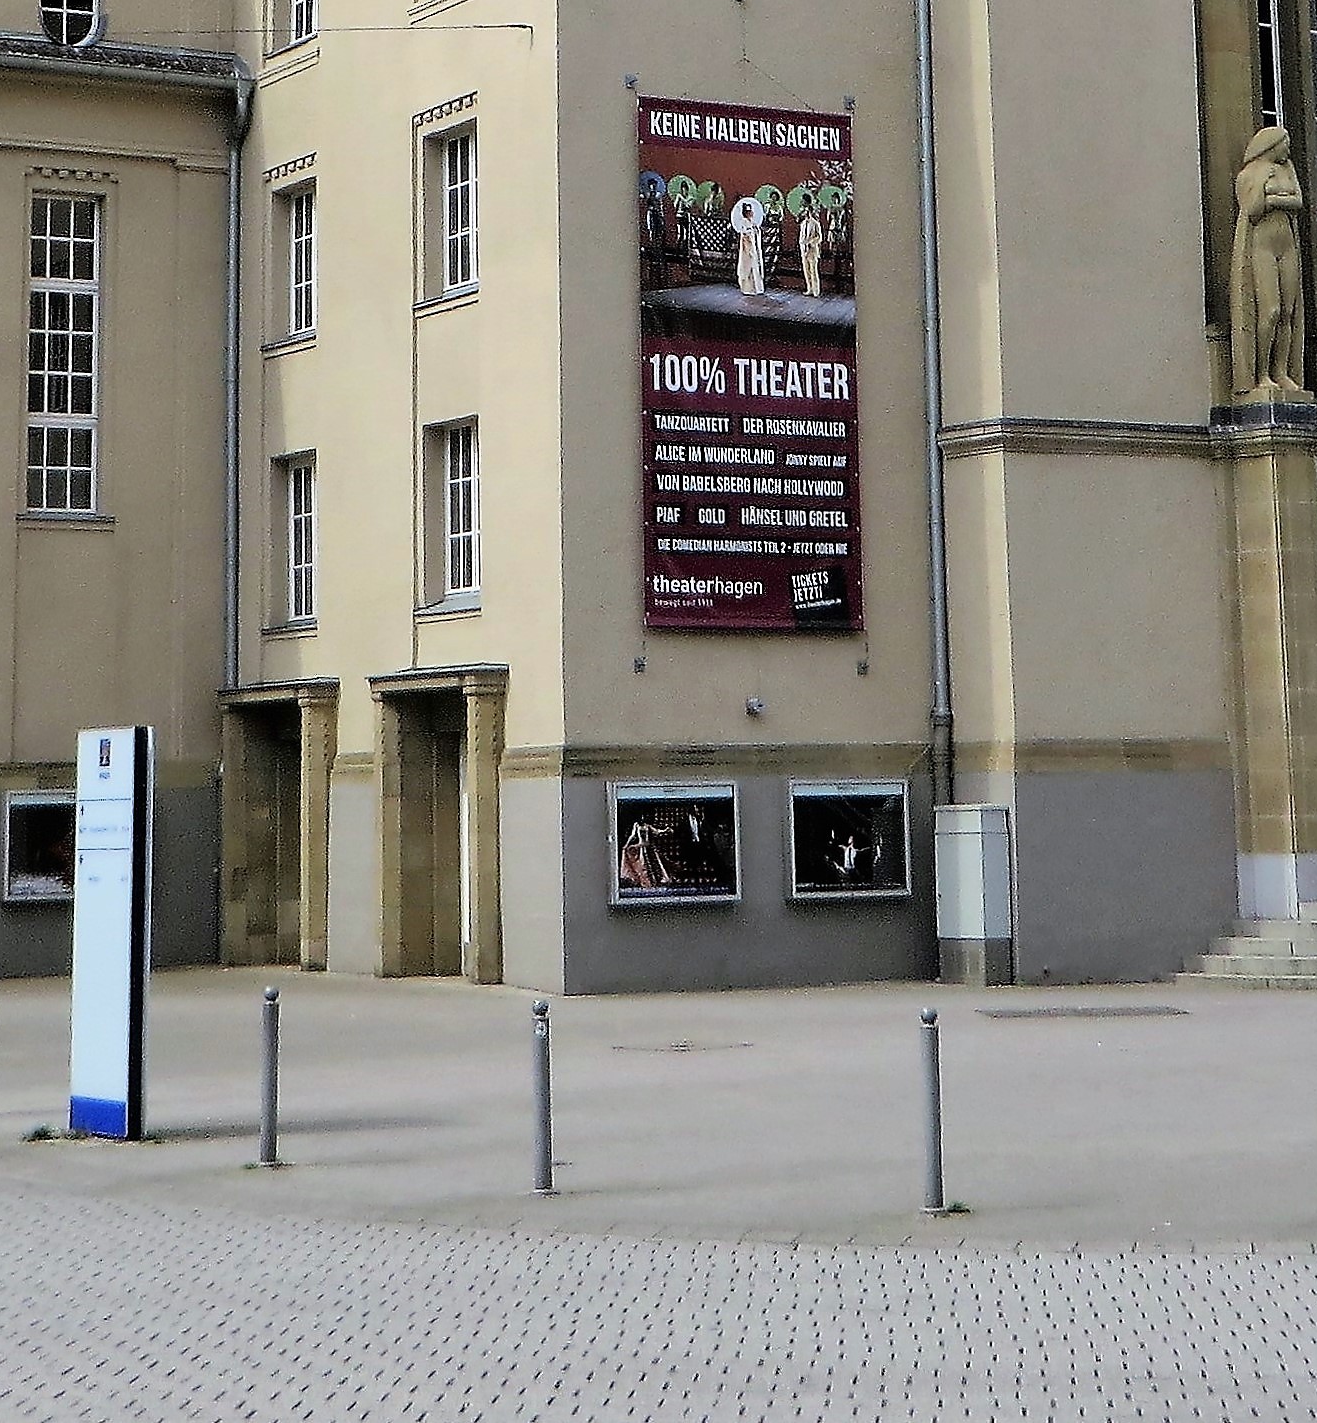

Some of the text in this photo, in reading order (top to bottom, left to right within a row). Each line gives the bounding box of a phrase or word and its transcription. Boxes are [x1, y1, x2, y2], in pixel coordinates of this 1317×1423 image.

[650, 111, 840, 151] KEINE HALBEN SACHEN
[650, 354, 849, 400] 100% THEATER
[655, 415, 730, 433] TANZQUARTETT
[743, 417, 846, 437] DER ROSENKAVALIER
[655, 445, 775, 465] ALICE IM WUNDERLAND
[656, 474, 844, 496] VON BABELSBERG NACH HOLLYWOOD
[656, 507, 681, 523] PIAF
[698, 508, 725, 524] GOLD
[741, 506, 848, 527] HÄNSEL UND GRETEL
[653, 575, 763, 598] theaterhagen
[792, 571, 829, 589] TICKETS
